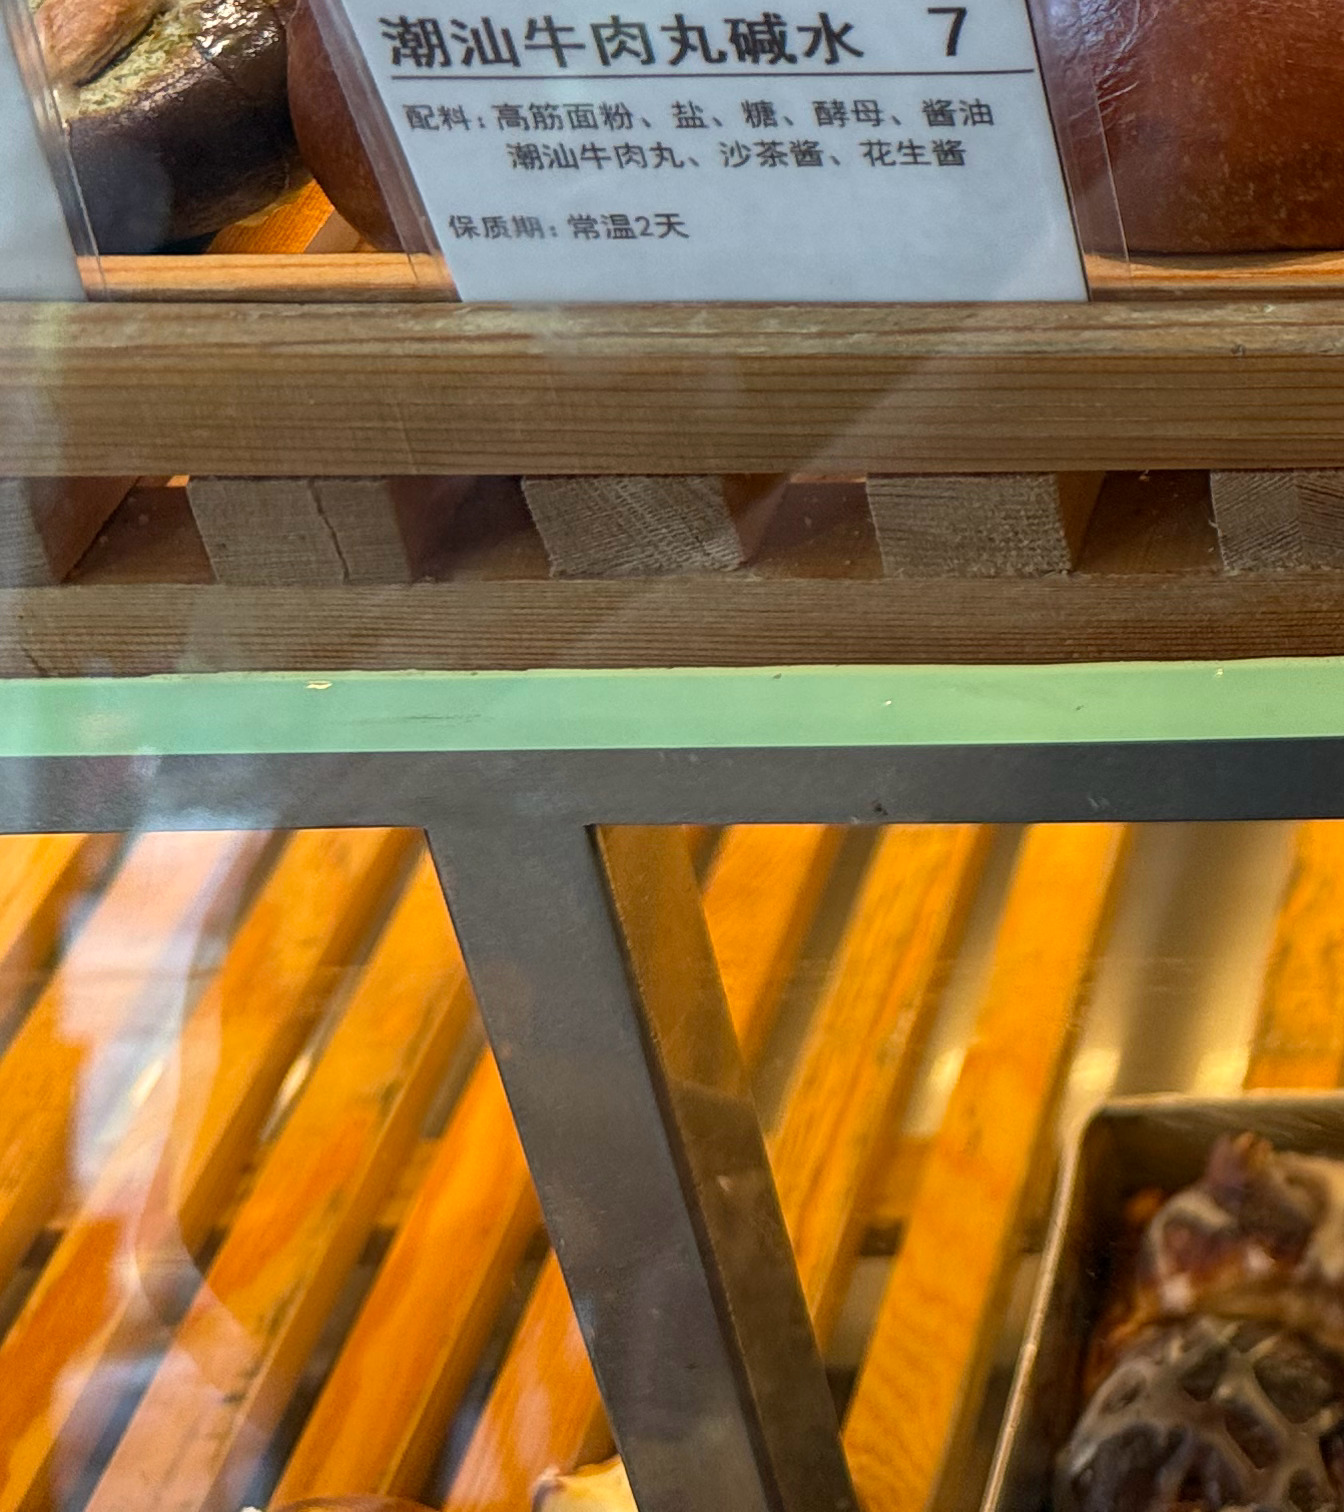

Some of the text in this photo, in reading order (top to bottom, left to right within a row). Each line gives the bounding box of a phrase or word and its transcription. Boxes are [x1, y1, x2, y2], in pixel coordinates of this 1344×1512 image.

[379, 12, 864, 68] 潮汕牛肉丸碱水
[927, 7, 967, 57] 7
